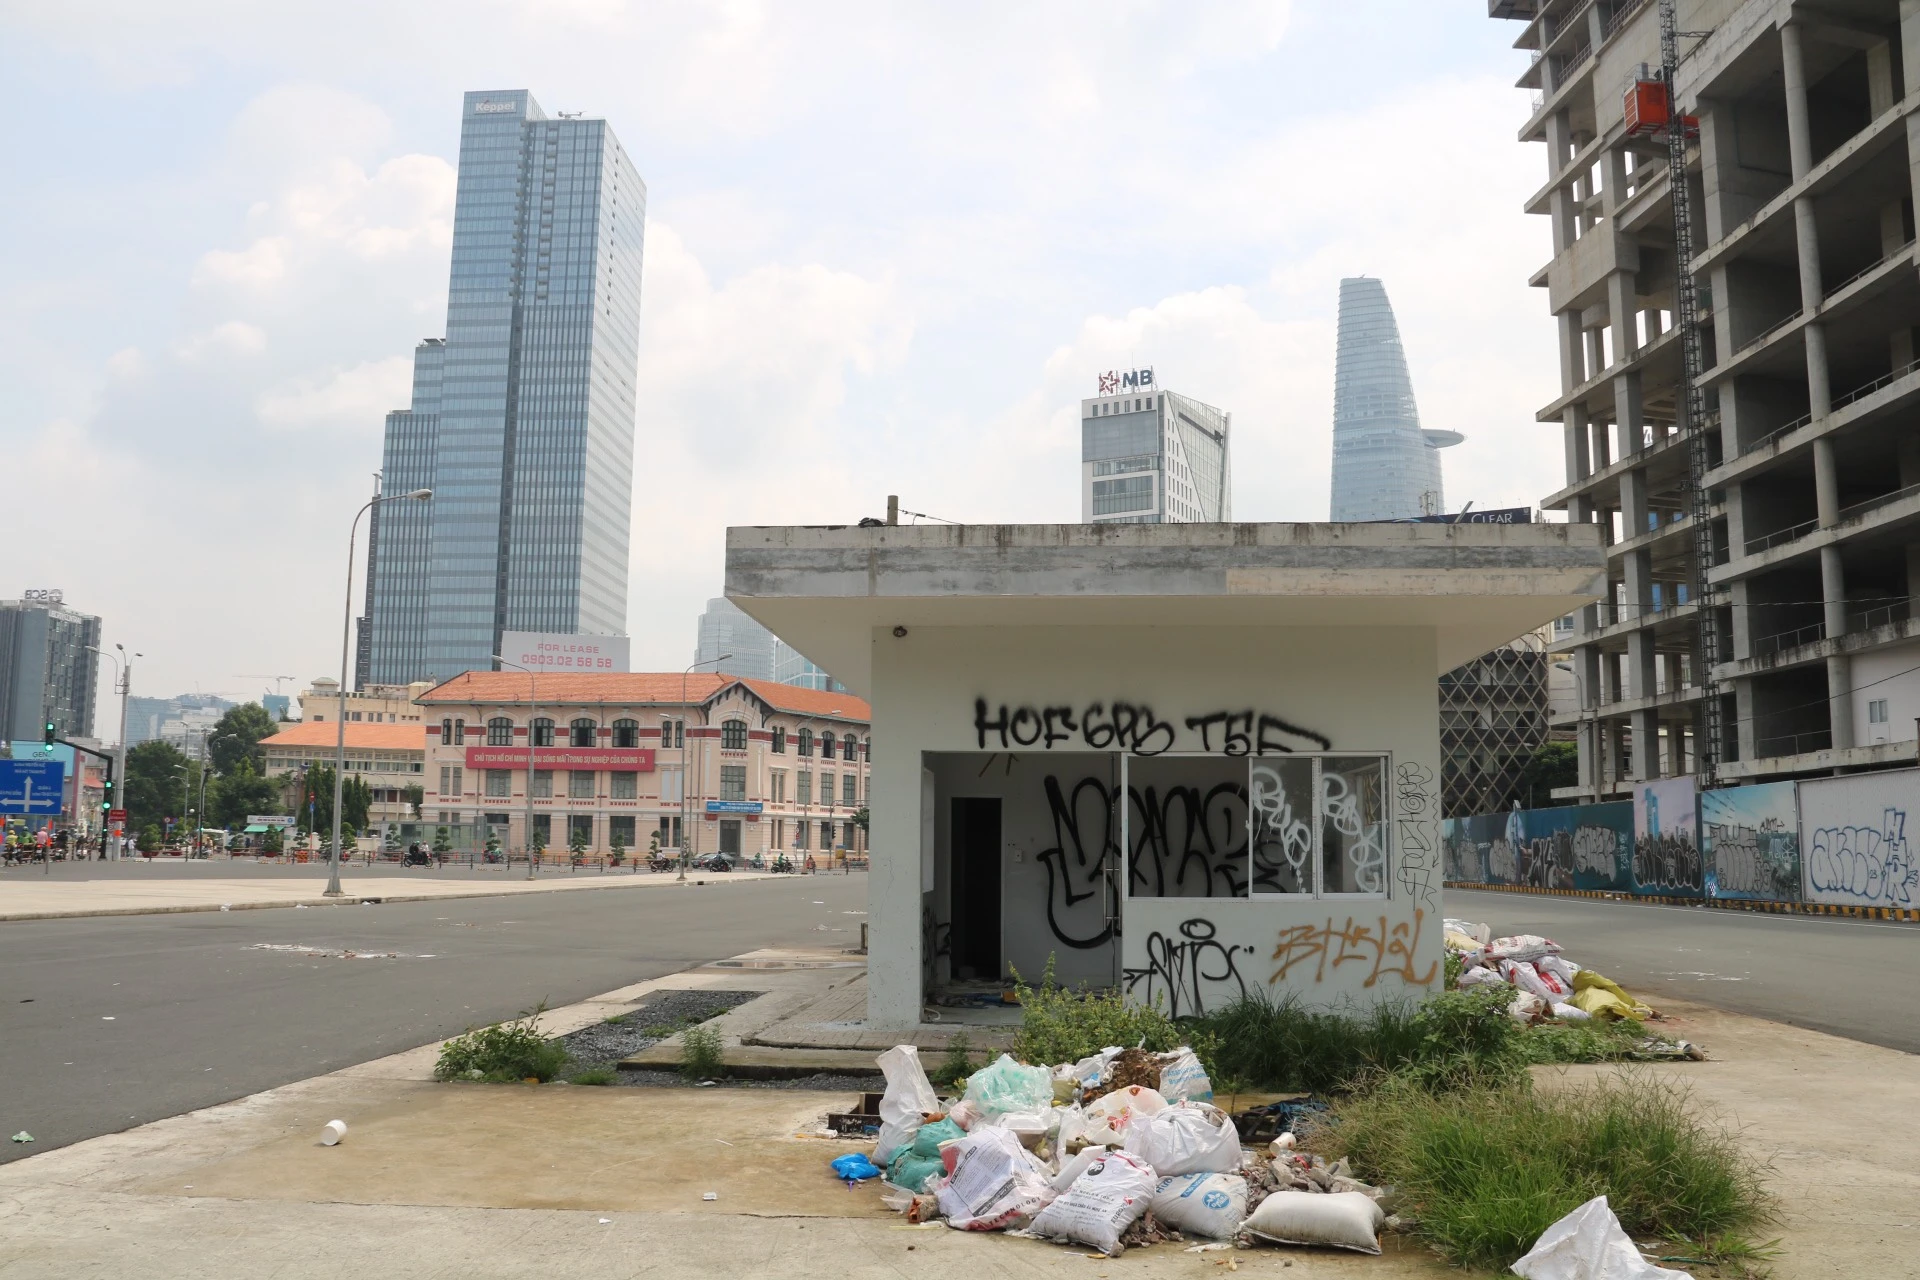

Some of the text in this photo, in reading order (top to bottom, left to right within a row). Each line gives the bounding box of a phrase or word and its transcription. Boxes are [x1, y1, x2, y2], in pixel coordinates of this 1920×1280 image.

[475, 101, 515, 113] Keppel
[1122, 369, 1153, 388] MB
[537, 643, 600, 654] FOR LEASE
[522, 654, 612, 668] 0903.02 58 58
[639, 756, 646, 764] TA
